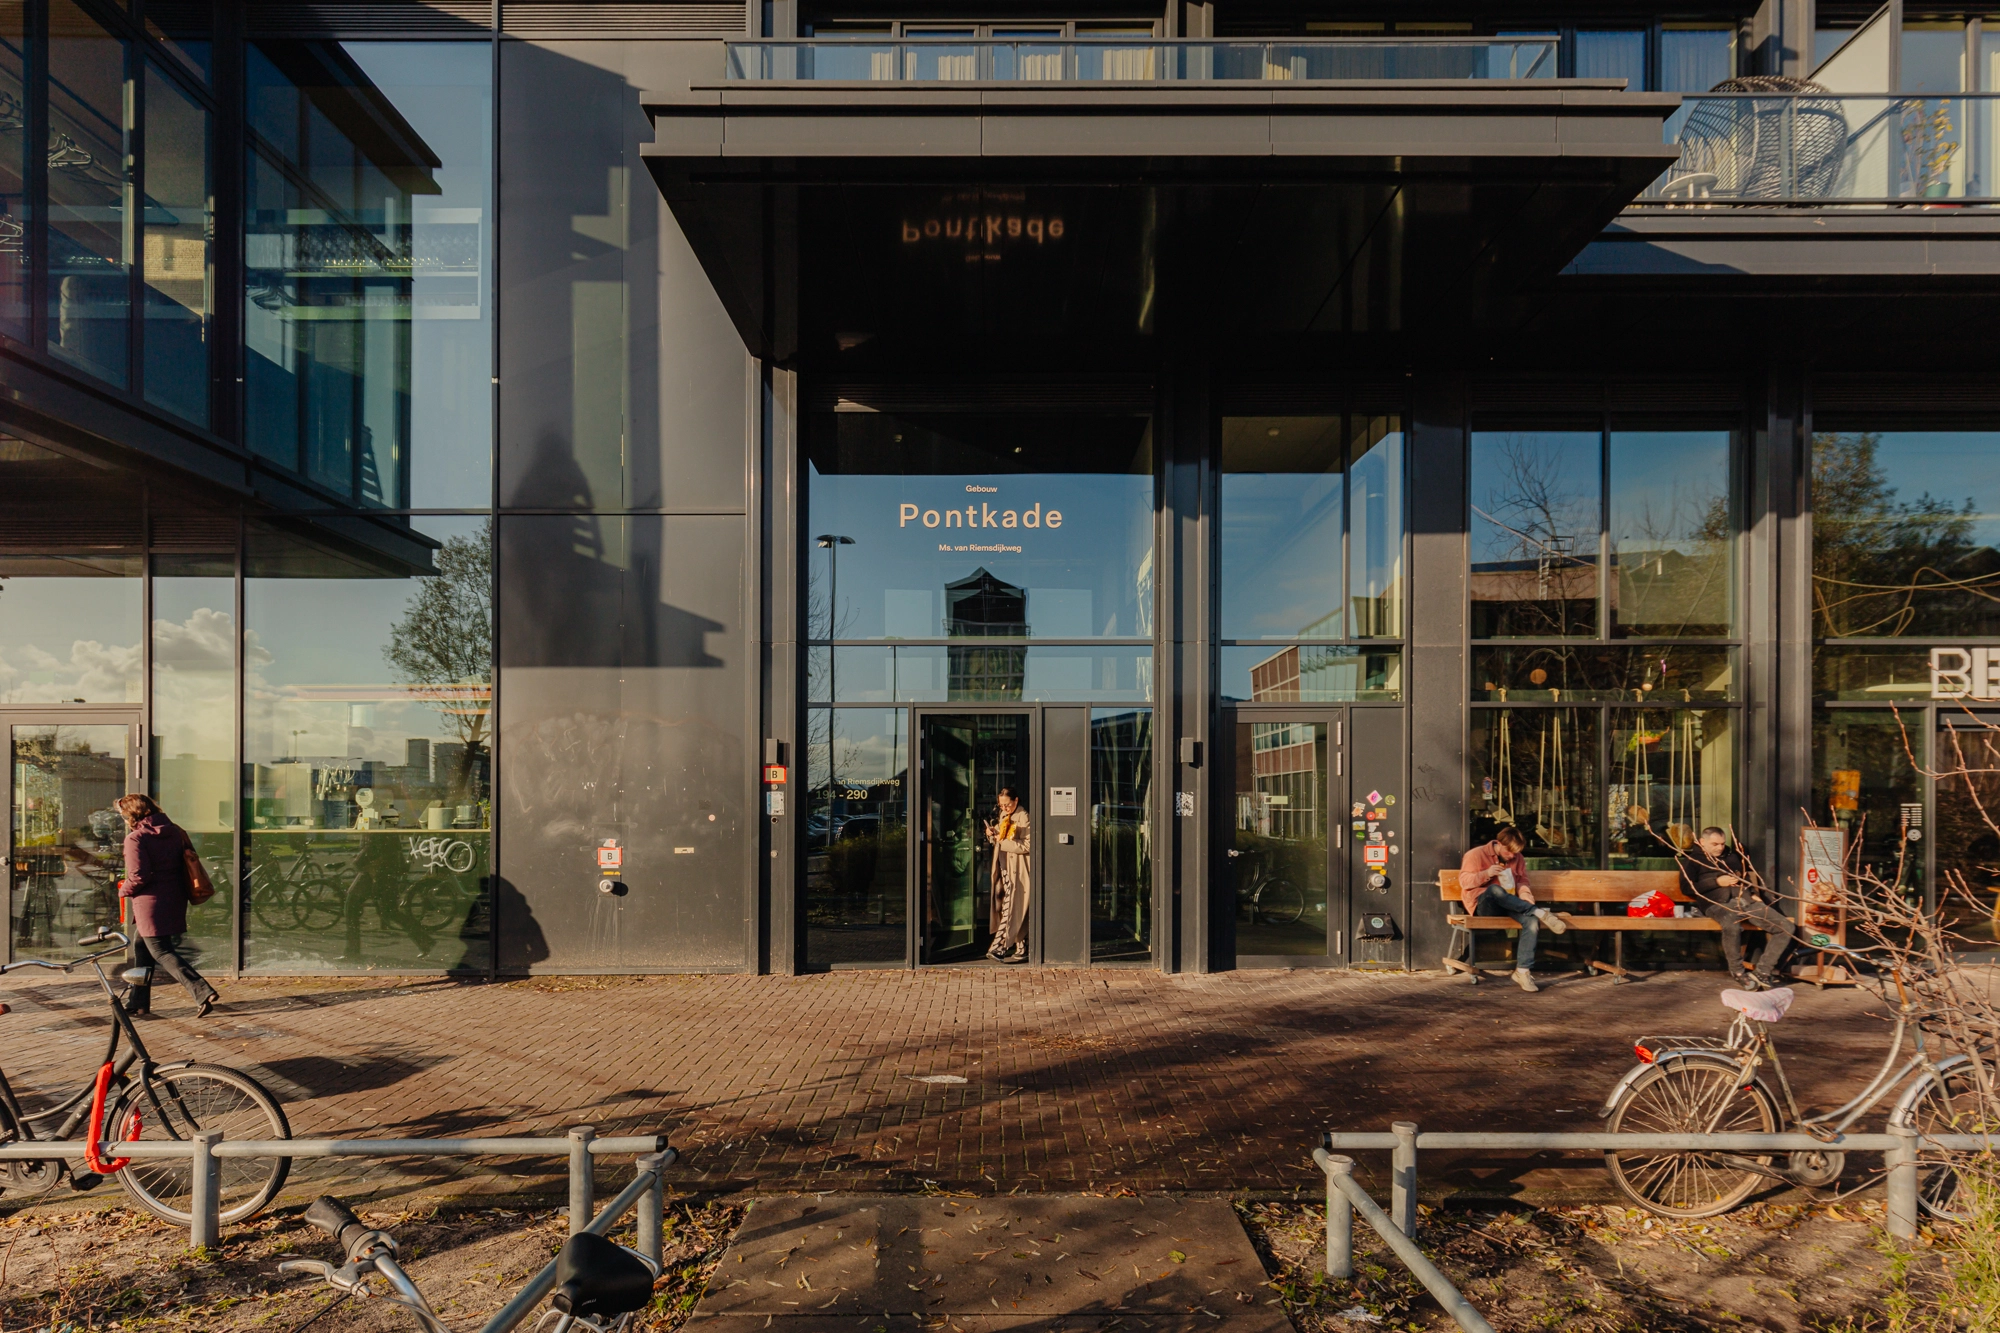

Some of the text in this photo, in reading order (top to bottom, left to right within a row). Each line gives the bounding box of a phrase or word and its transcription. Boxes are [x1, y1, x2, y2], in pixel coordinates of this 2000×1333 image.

[965, 484, 998, 493] Gebouw
[899, 502, 1063, 529] Pontkade
[938, 543, 953, 552] Ms.
[969, 543, 1022, 554] Riemsdijkweg
[847, 777, 900, 787] Riemsdijkweg
[846, 789, 868, 800] 290
